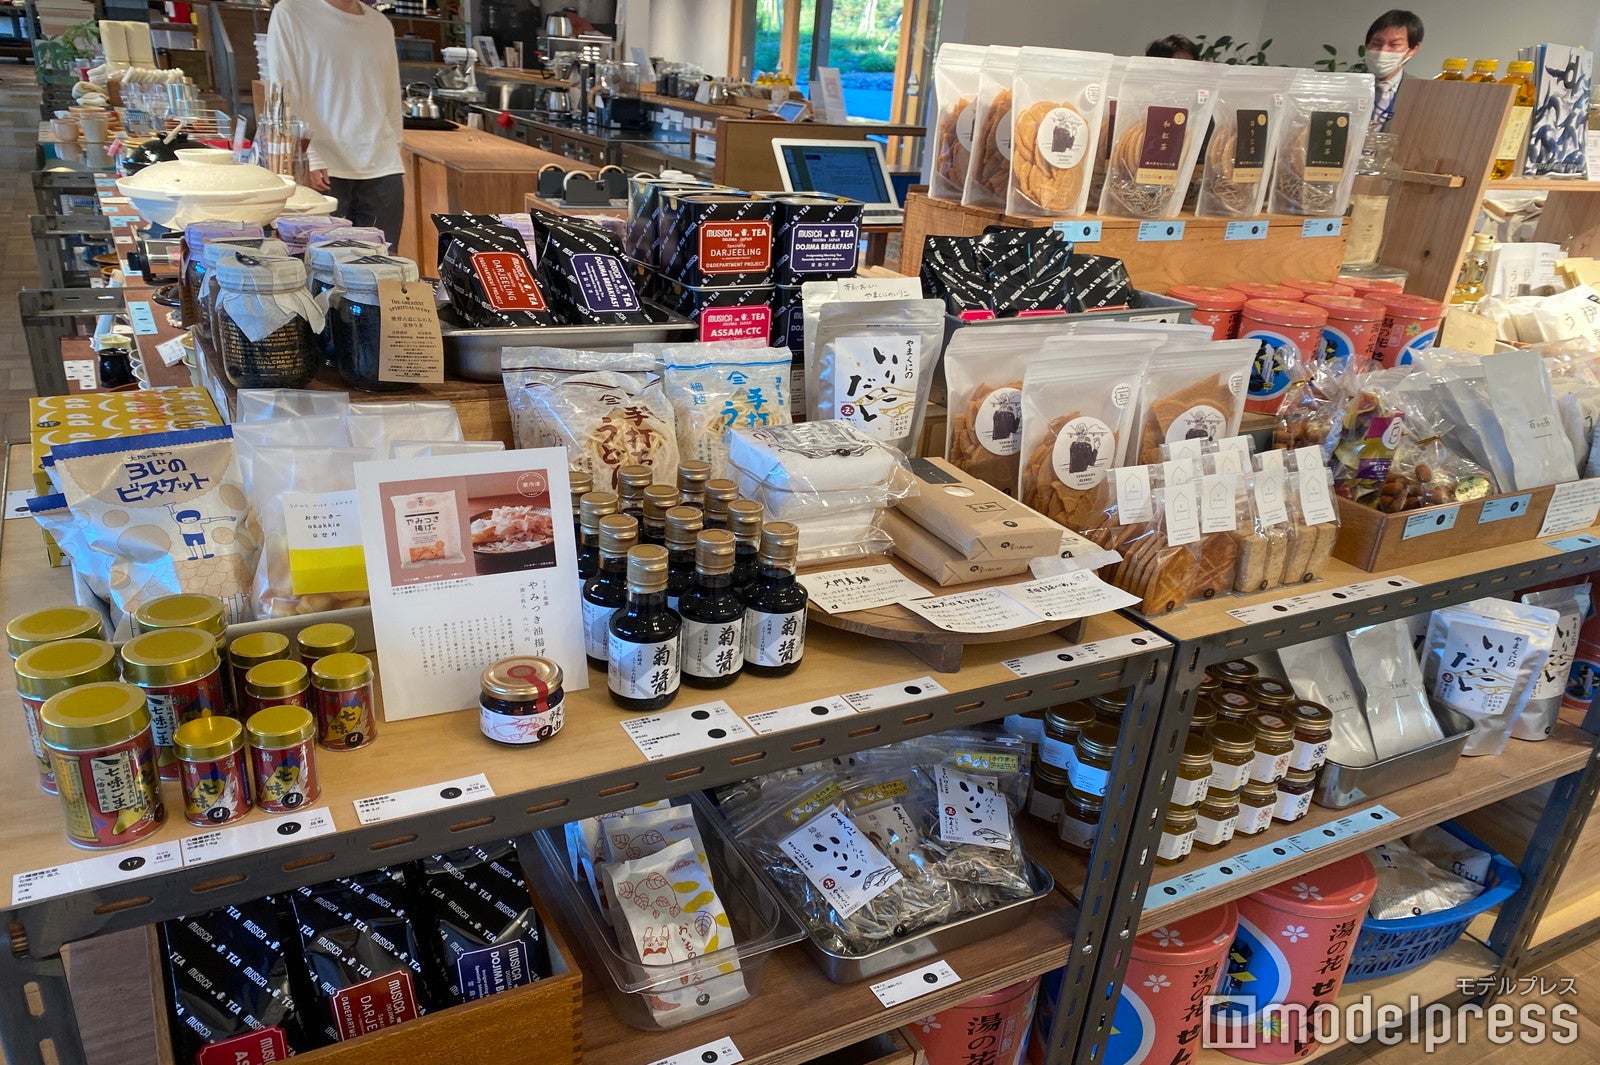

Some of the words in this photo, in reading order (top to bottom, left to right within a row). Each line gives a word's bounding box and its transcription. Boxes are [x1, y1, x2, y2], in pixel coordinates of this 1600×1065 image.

[706, 229, 732, 237] MUSICA
[752, 228, 766, 237] TEA
[798, 230, 823, 238] MUSICA
[840, 229, 854, 238] TEA
[586, 243, 597, 252] TEA
[710, 248, 761, 257] DARJEELING
[492, 259, 517, 301] DARJEELING
[492, 286, 504, 305] PROJECT
[527, 292, 539, 306] TEA
[603, 277, 620, 308] BREAKFAST
[622, 293, 634, 307] TEA
[708, 314, 732, 322] MUSICA
[751, 313, 765, 321] TEA
[904, 340, 914, 379] やまくにの
[846, 374, 878, 422] だし
[624, 406, 653, 465] 手打ち
[115, 472, 209, 503] ビスケット
[406, 515, 440, 526] やみつき
[414, 524, 432, 533] 揚げ
[528, 581, 547, 657] やみつき油揚げ
[1506, 637, 1523, 668] やまくにの
[330, 710, 356, 734] 七味
[104, 767, 127, 809] 七味ごま
[266, 770, 293, 796] 七味
[192, 783, 218, 809] 七味
[475, 848, 488, 862] TEA
[443, 861, 465, 881] MUSICA
[489, 861, 512, 879] MUSICA
[349, 882, 364, 895] TEA
[430, 887, 445, 900] TEA
[478, 888, 492, 902] TEA
[314, 897, 338, 913] MUSICA
[367, 893, 391, 909] MUSICA
[447, 900, 470, 920] MUSICA
[226, 906, 242, 920] TEA
[187, 922, 212, 943] MUSICA
[242, 919, 266, 941] MUSICA
[353, 919, 369, 933] TEA
[370, 932, 395, 952] MUSICA
[482, 929, 498, 943] TEA
[317, 936, 342, 957] MUSICA
[170, 952, 186, 967] TEA
[226, 952, 242, 967] TEA
[408, 958, 422, 973] TEA
[508, 947, 522, 981] MUSICA
[187, 967, 212, 990] MUSICA
[243, 966, 267, 988] MUSICA
[357, 963, 372, 978] TEA
[388, 979, 405, 1014] MUSICA
[226, 1000, 242, 1015] TEA
[185, 1016, 212, 1038] MUSICA
